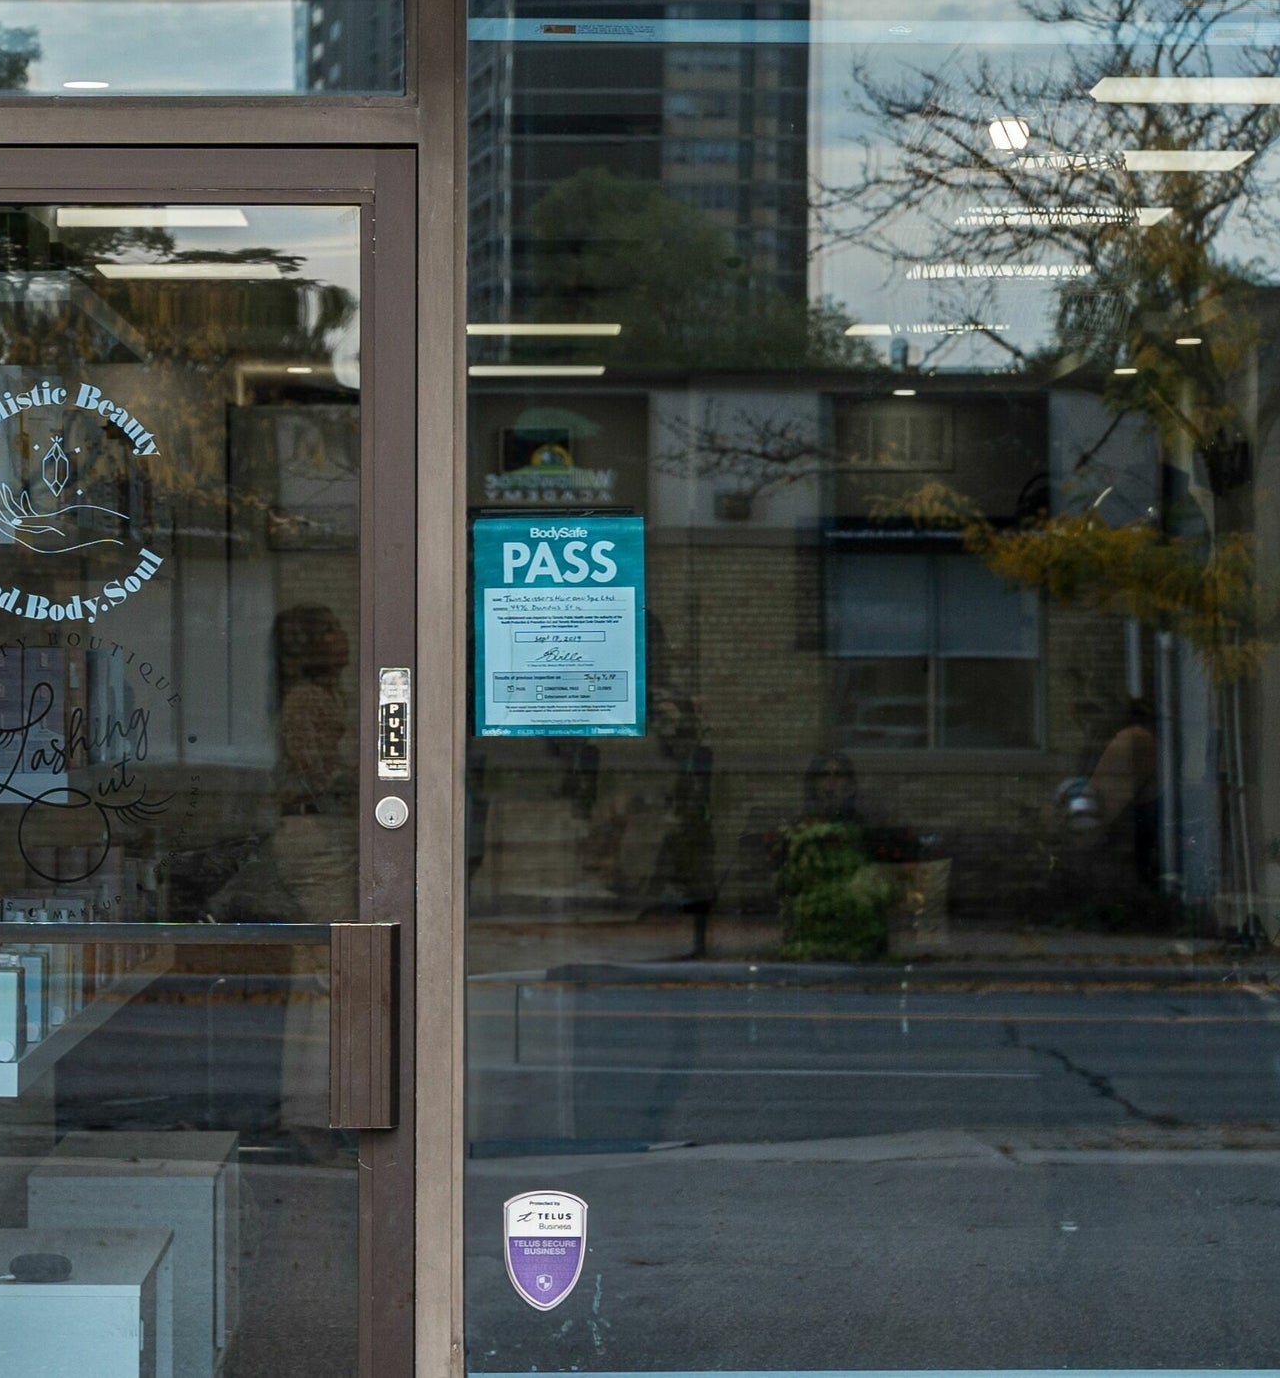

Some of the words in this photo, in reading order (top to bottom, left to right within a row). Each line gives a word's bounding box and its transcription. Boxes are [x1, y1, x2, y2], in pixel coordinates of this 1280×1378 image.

[73, 382, 162, 459] Beauty
[529, 526, 589, 541] BodySafe
[502, 540, 618, 584] PASS
[47, 632, 183, 708] BOUTIQUE
[389, 704, 400, 757] PULL
[524, 1247, 566, 1255] BUSINESS
